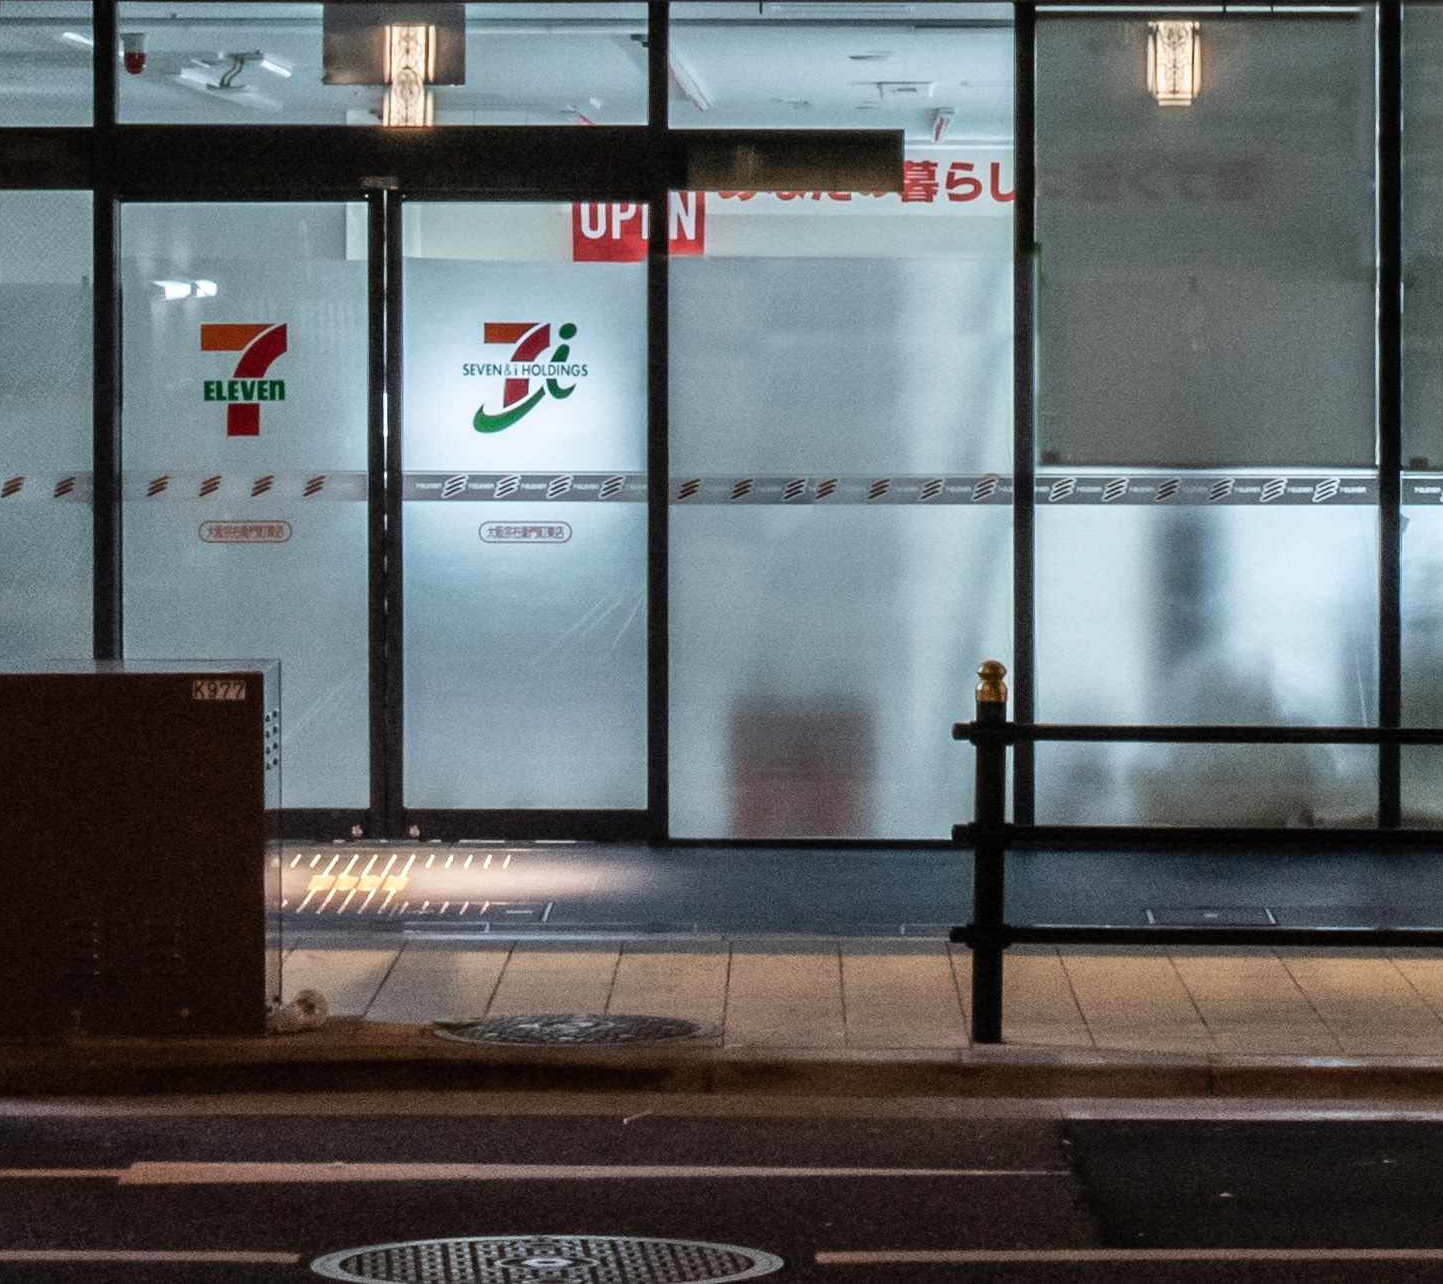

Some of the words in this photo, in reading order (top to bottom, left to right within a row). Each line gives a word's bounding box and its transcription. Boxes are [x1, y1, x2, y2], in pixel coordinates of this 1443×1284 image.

[578, 190, 697, 241] OPN
[521, 364, 588, 377] HOLDINGS
[194, 680, 244, 700] K977
